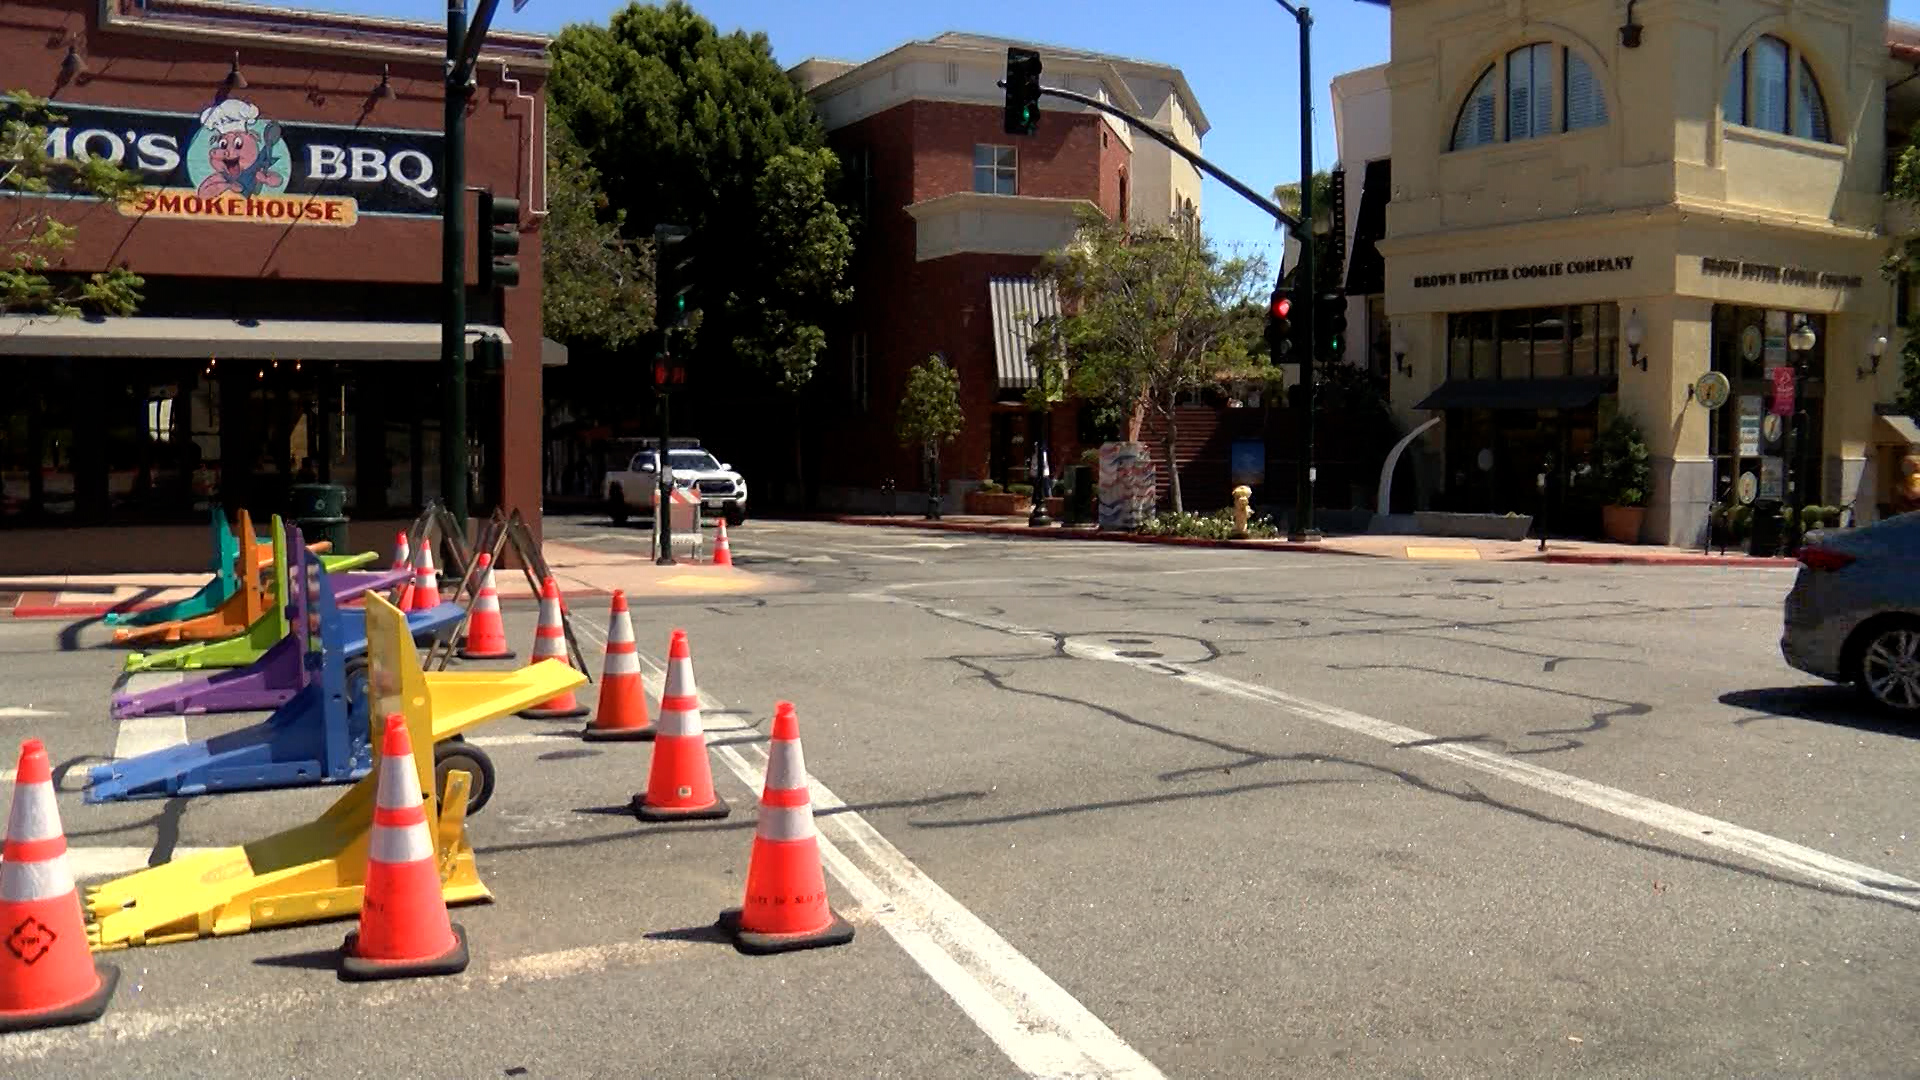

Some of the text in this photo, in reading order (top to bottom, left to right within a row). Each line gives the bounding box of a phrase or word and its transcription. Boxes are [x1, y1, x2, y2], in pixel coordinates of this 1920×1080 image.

[307, 144, 439, 198] BBQ
[135, 191, 344, 220] SMOKEHOUSE
[1414, 256, 1634, 288] BROWN BUTTER COOKIE COMPANY
